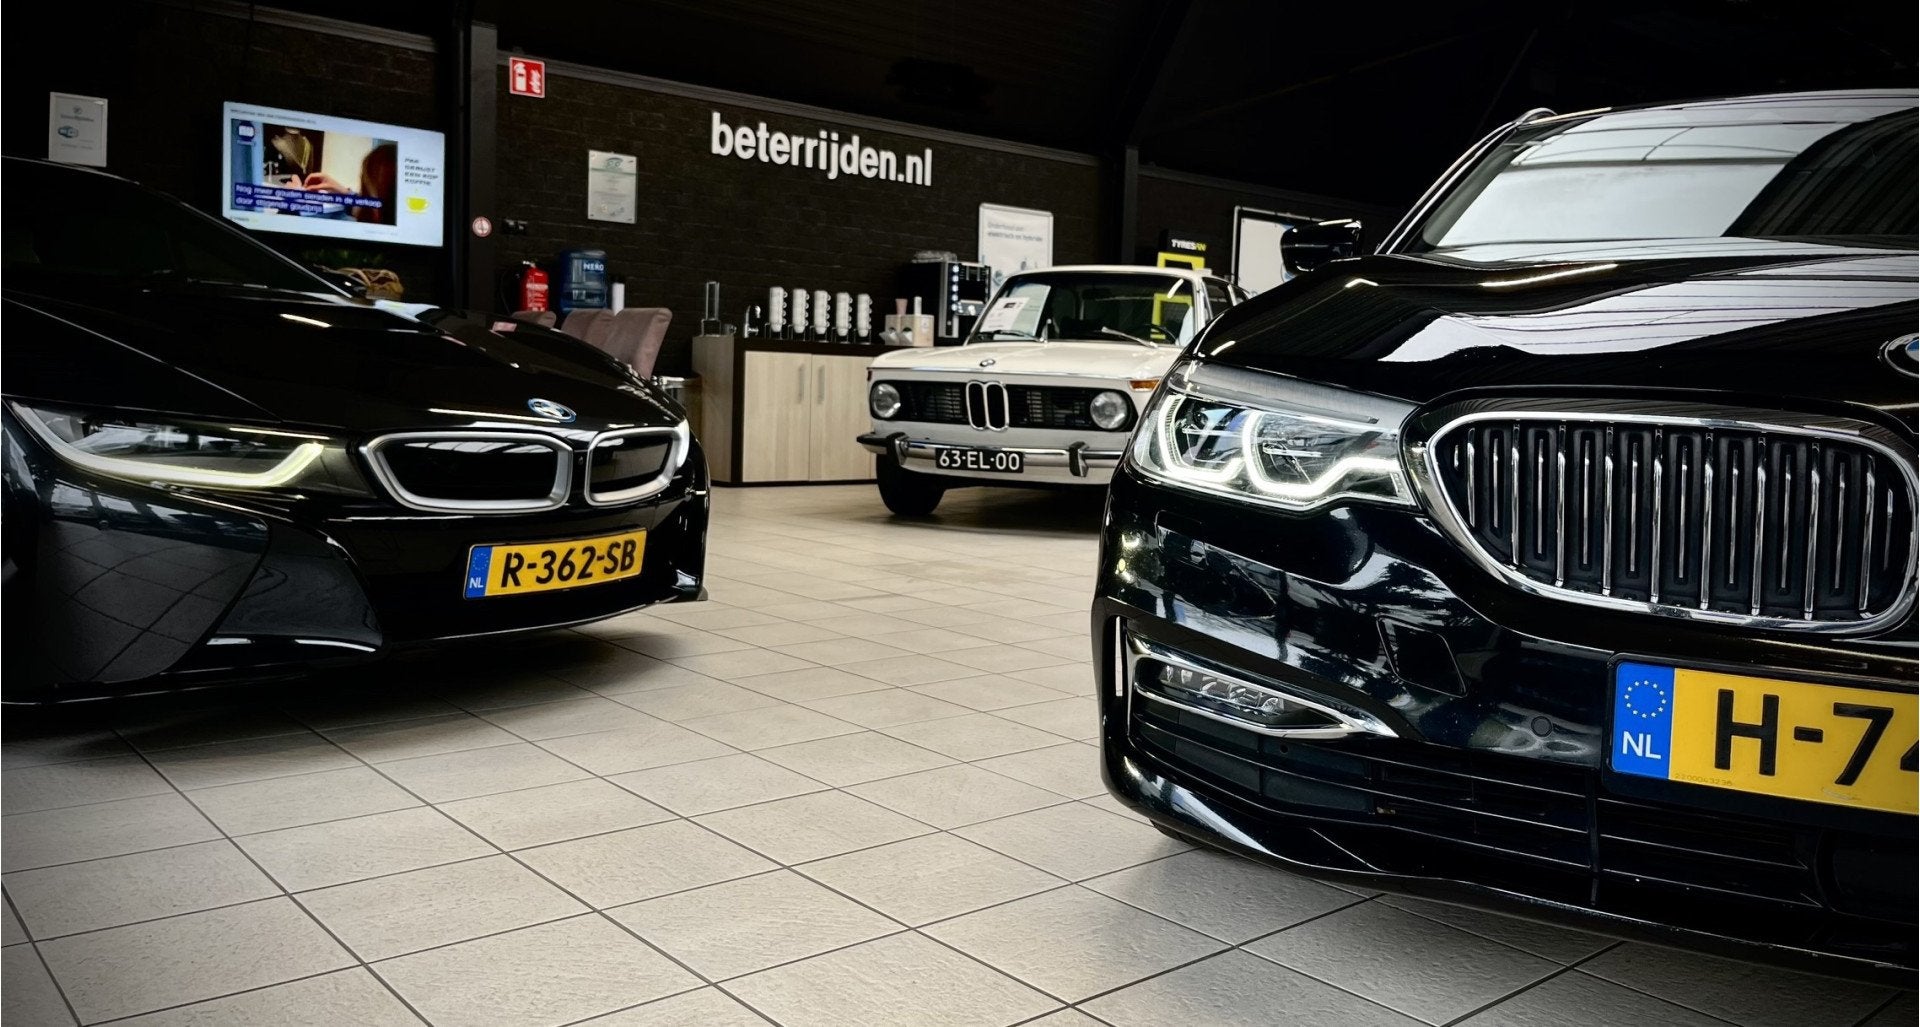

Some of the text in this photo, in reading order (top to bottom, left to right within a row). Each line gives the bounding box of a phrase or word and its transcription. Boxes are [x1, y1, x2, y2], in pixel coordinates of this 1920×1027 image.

[711, 111, 933, 187] beterrijden.nl
[235, 184, 251, 196] Nog
[254, 187, 273, 196] meer
[275, 188, 302, 200] gouden
[335, 194, 342, 203] in
[344, 196, 353, 205] de
[355, 197, 382, 208] verkoop
[235, 196, 253, 205] door
[469, 539, 638, 589] NL R-362-SB
[1621, 730, 1662, 760] NL
